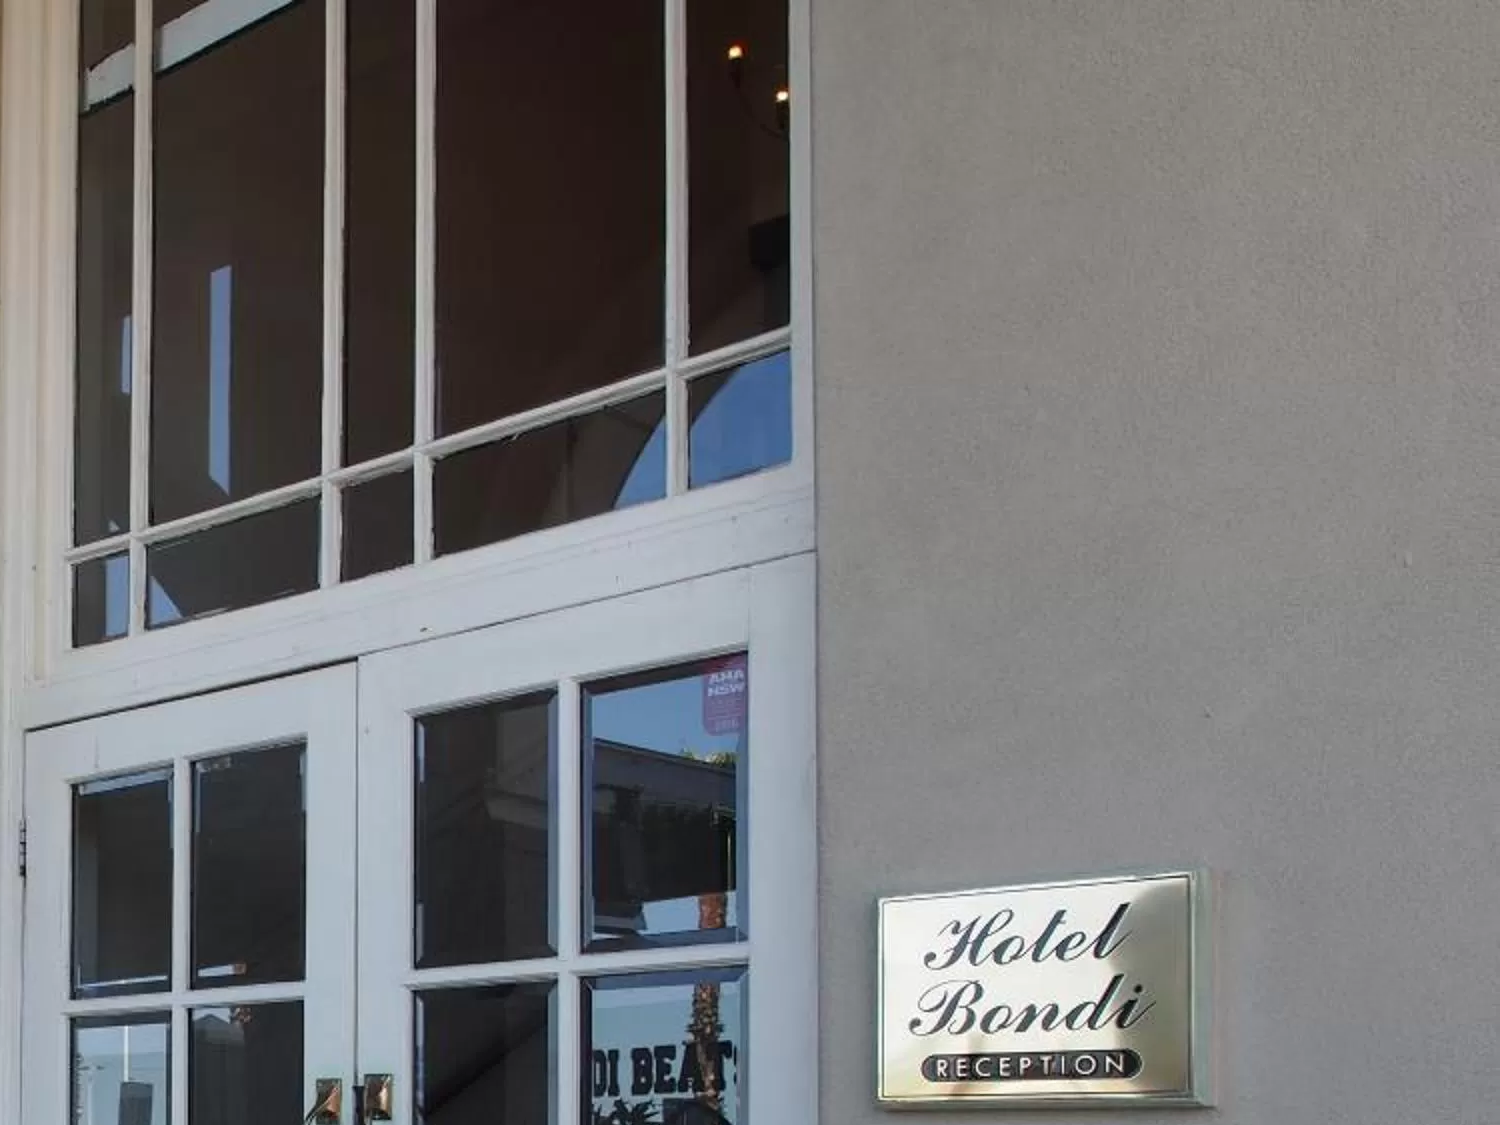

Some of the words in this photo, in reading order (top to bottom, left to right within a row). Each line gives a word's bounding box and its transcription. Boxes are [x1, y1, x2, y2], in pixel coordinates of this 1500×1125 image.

[924, 902, 1132, 971] Hotel
[909, 973, 1156, 1038] Bondi
[936, 1047, 1126, 1077] RECEPTION
